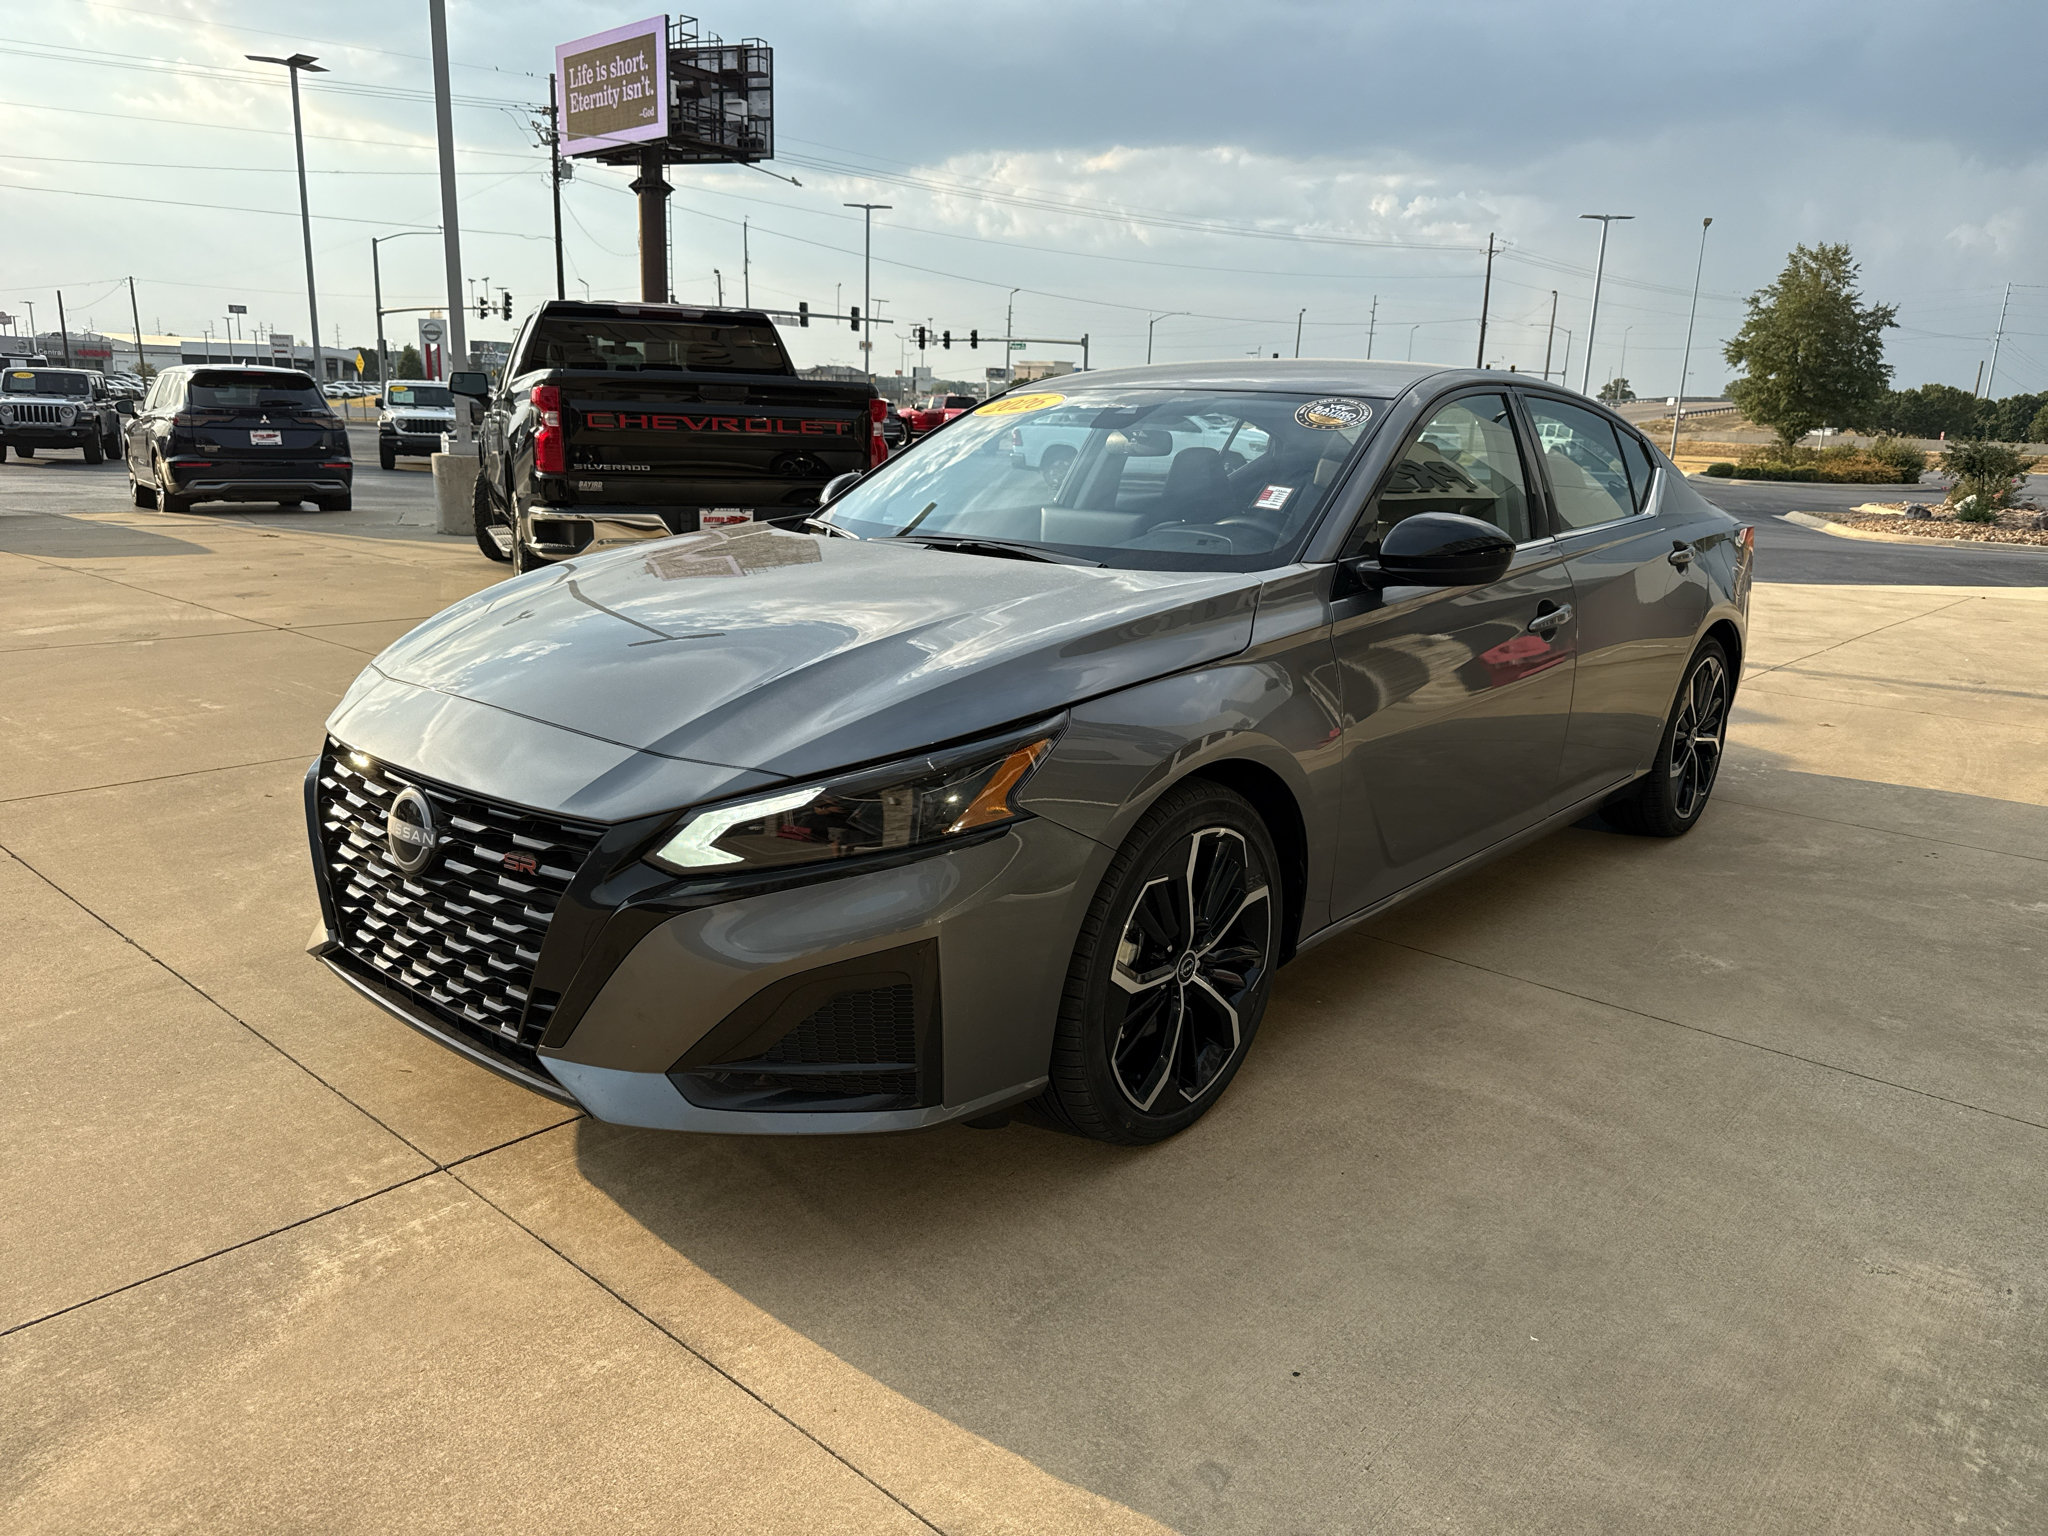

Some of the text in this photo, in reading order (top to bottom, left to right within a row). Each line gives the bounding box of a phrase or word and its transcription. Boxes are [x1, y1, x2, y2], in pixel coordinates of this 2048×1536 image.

[569, 50, 649, 89] Life is short.
[569, 75, 654, 114] Eternity isn't.
[38, 348, 64, 356] Central
[587, 412, 852, 435] CHEVROLET
[573, 463, 651, 471] SILVERADO
[503, 852, 538, 876] SR
